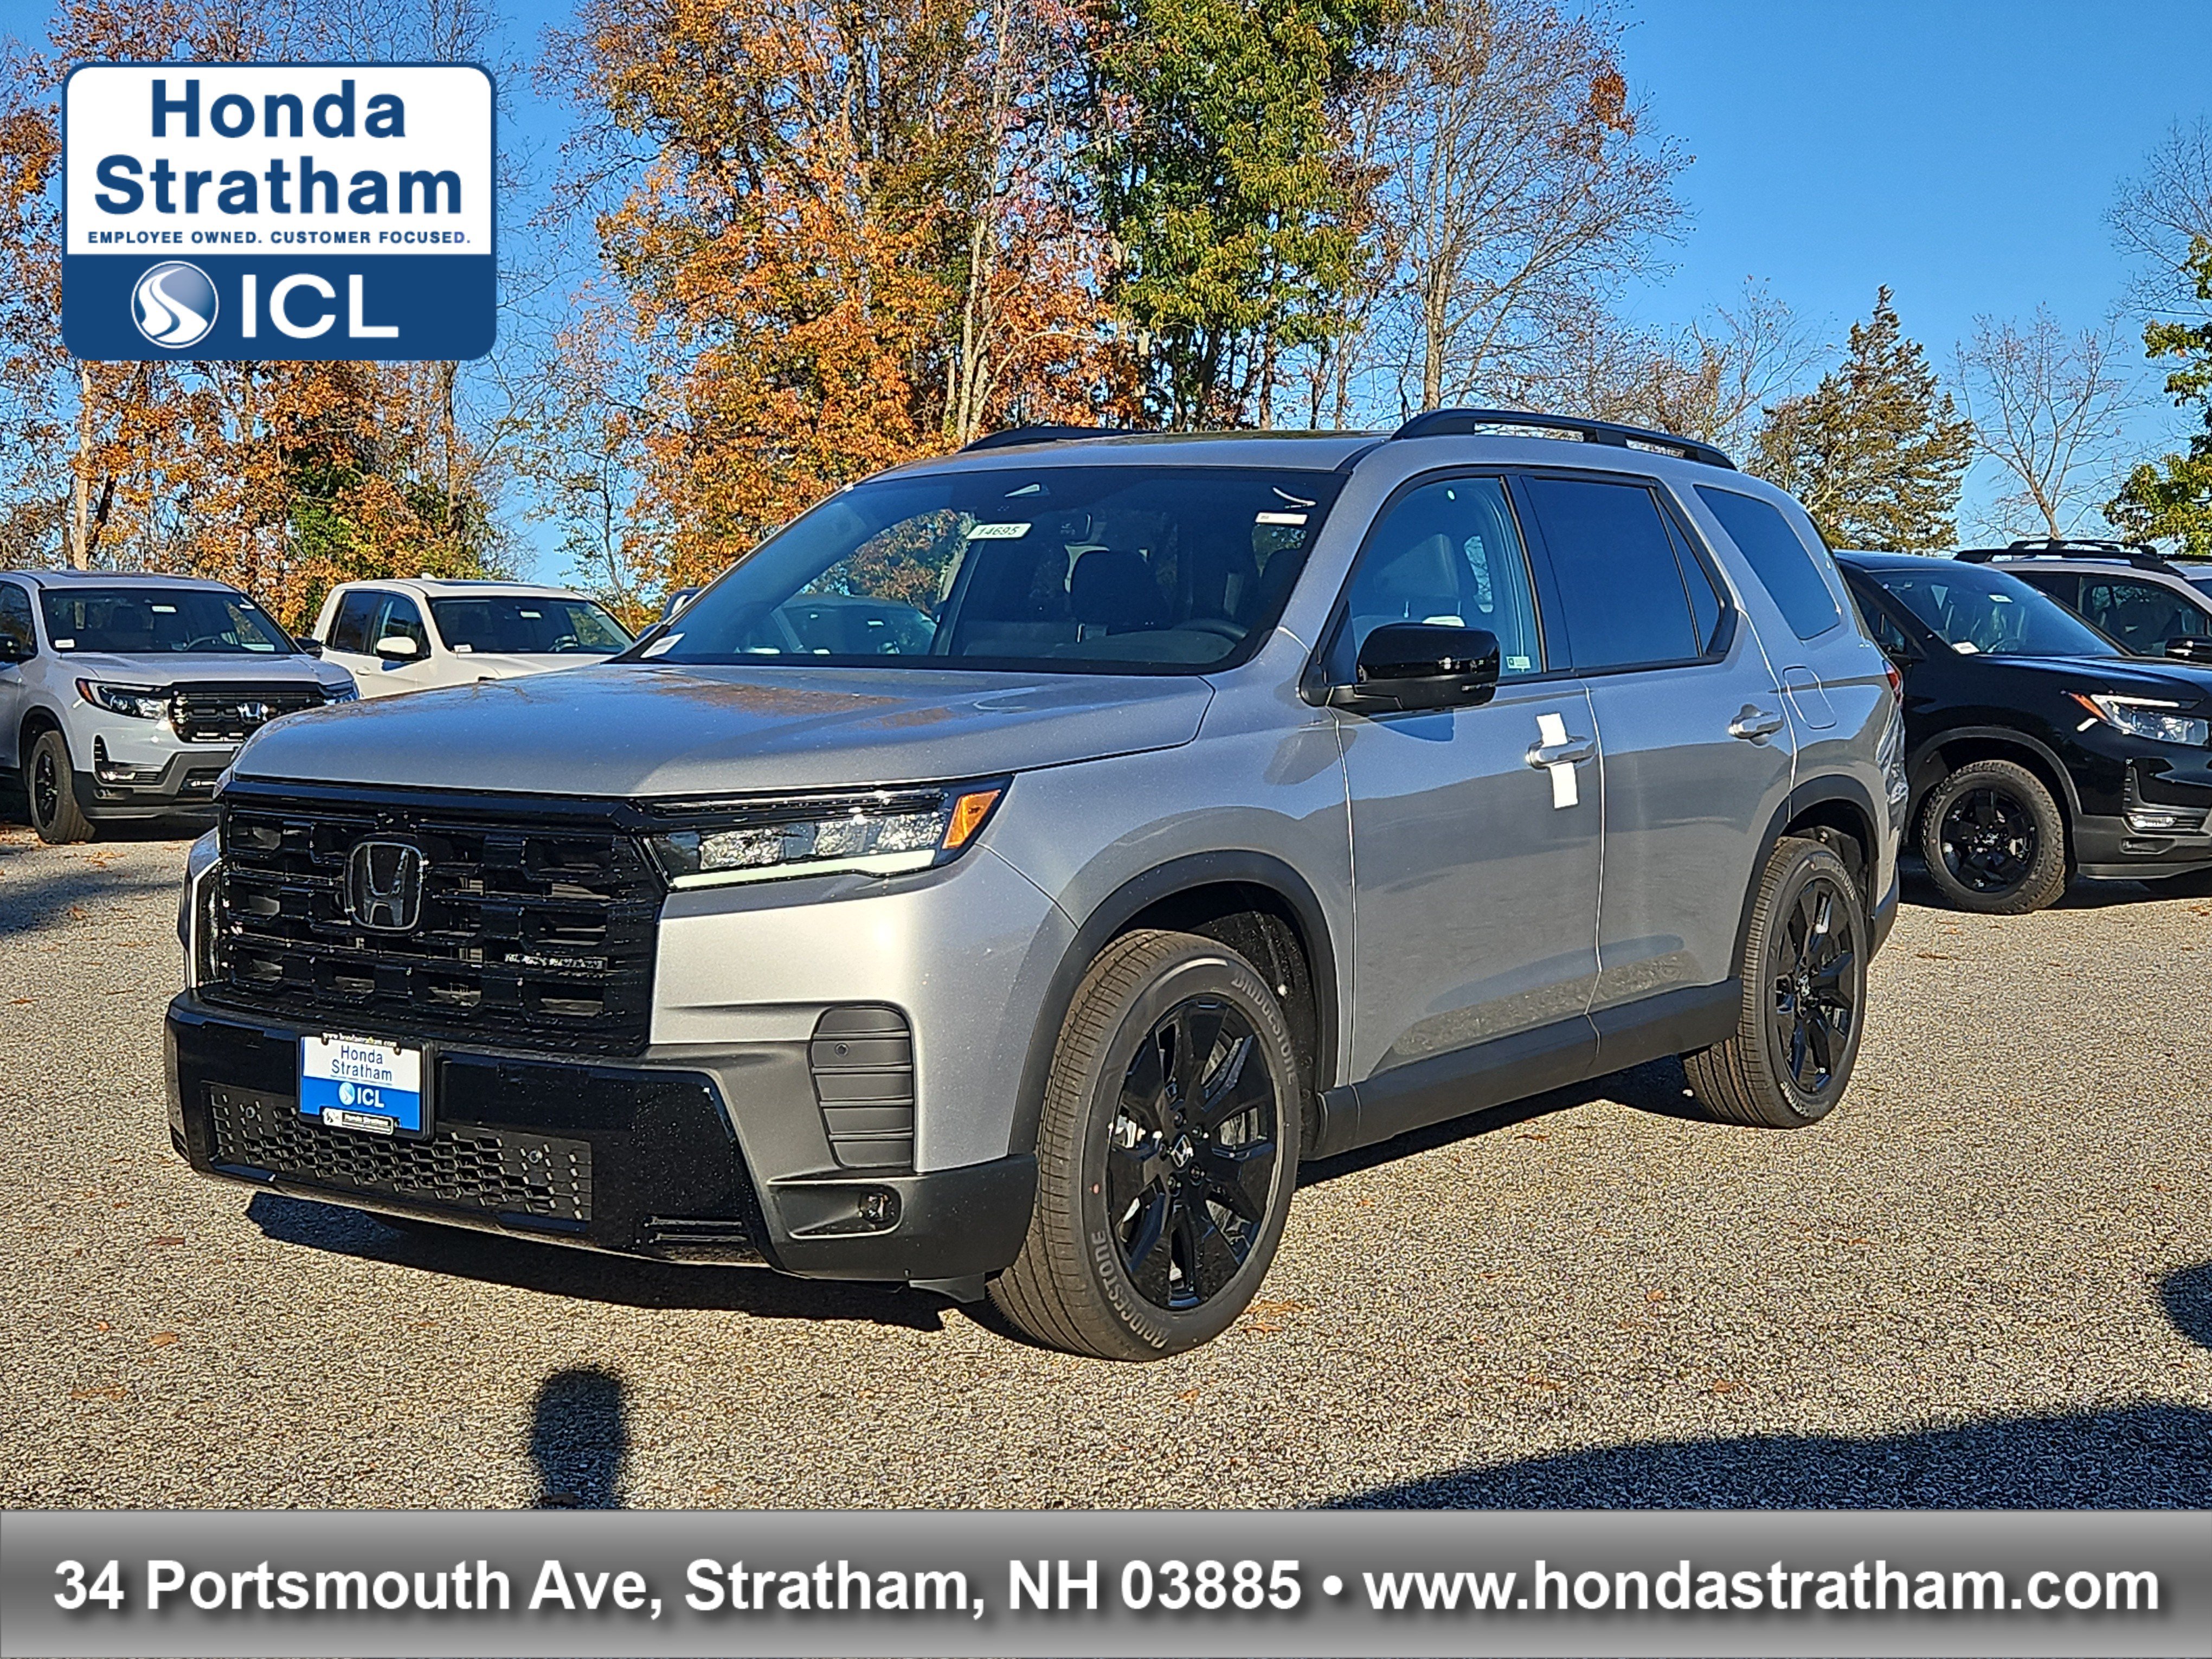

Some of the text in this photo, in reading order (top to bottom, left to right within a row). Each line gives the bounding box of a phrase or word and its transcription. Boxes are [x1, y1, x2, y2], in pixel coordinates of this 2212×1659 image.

[978, 526, 1021, 536] 14695
[341, 1045, 383, 1064] Honda
[331, 1058, 393, 1082] Stratham
[357, 1086, 385, 1108] ICL
